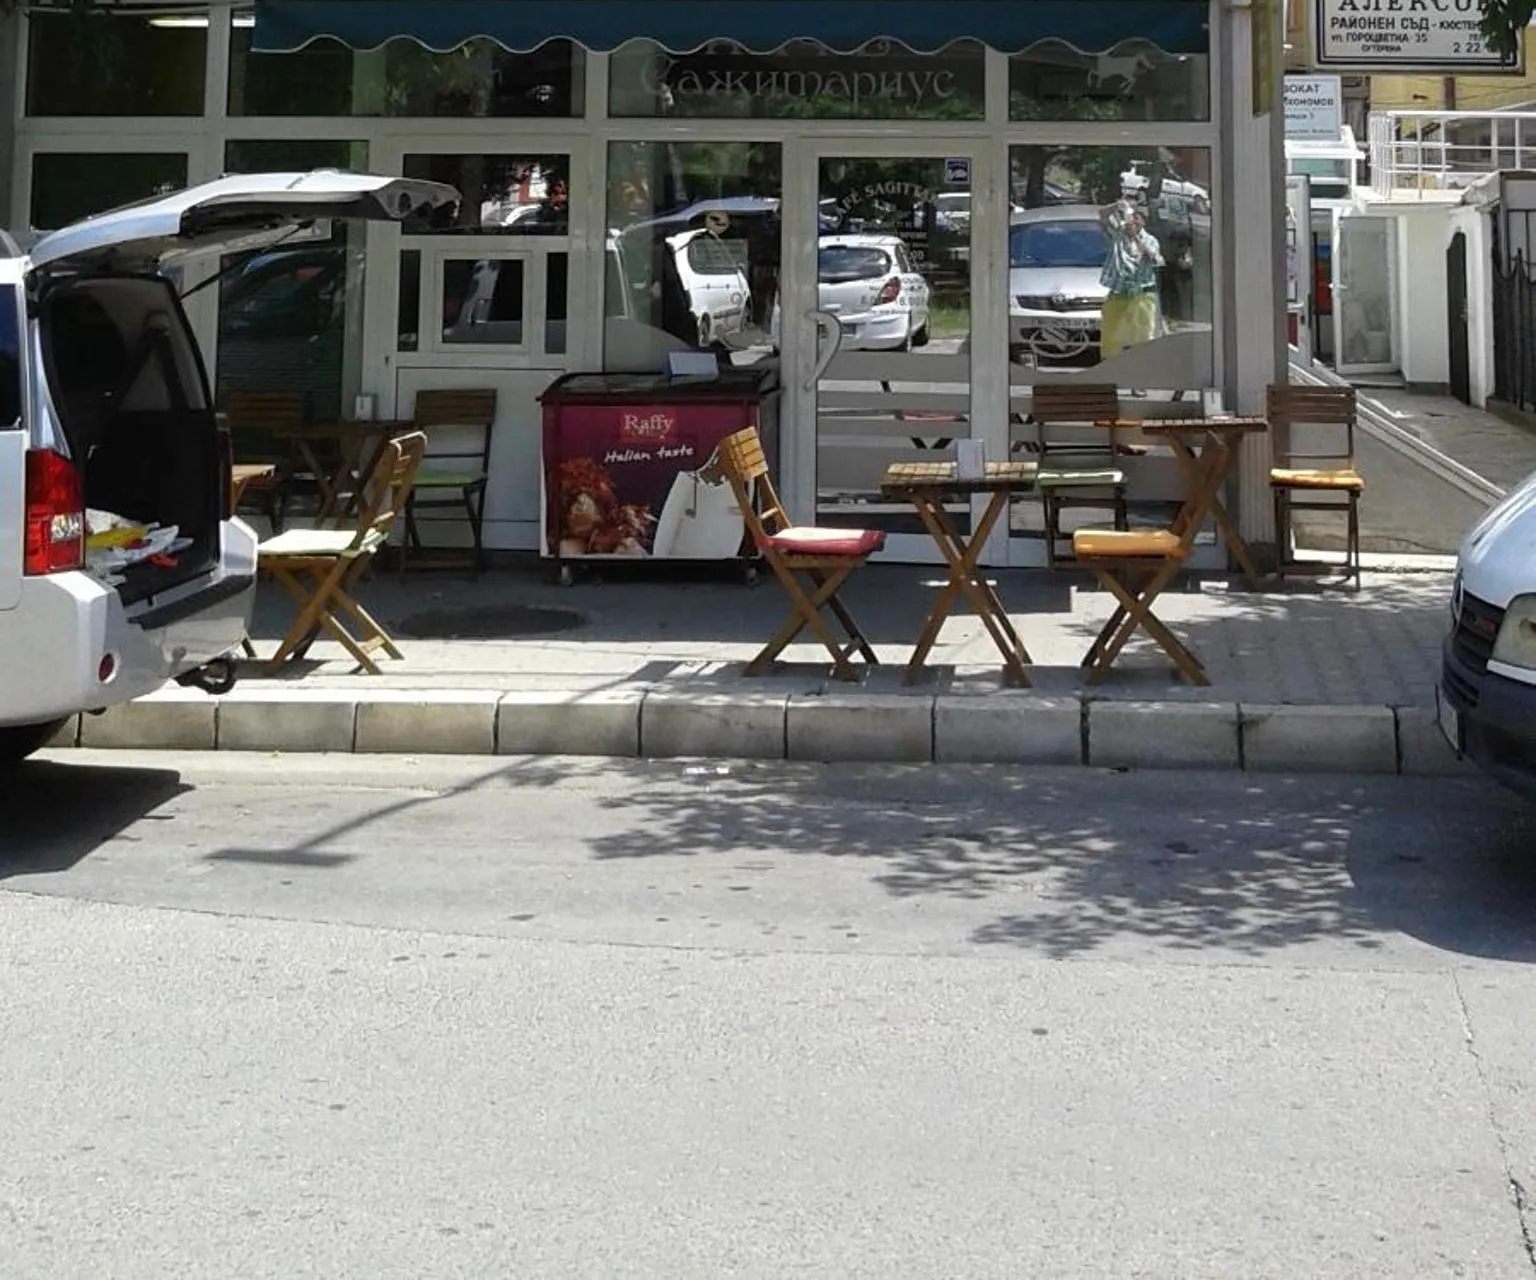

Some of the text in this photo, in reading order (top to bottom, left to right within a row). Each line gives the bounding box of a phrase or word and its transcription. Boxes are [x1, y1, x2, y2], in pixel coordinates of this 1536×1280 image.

[1331, 15, 1395, 30] РАЙОНЕН
[1400, 17, 1429, 31] СЪД
[623, 413, 675, 434] Raffy
[604, 444, 694, 463] Italian taste
